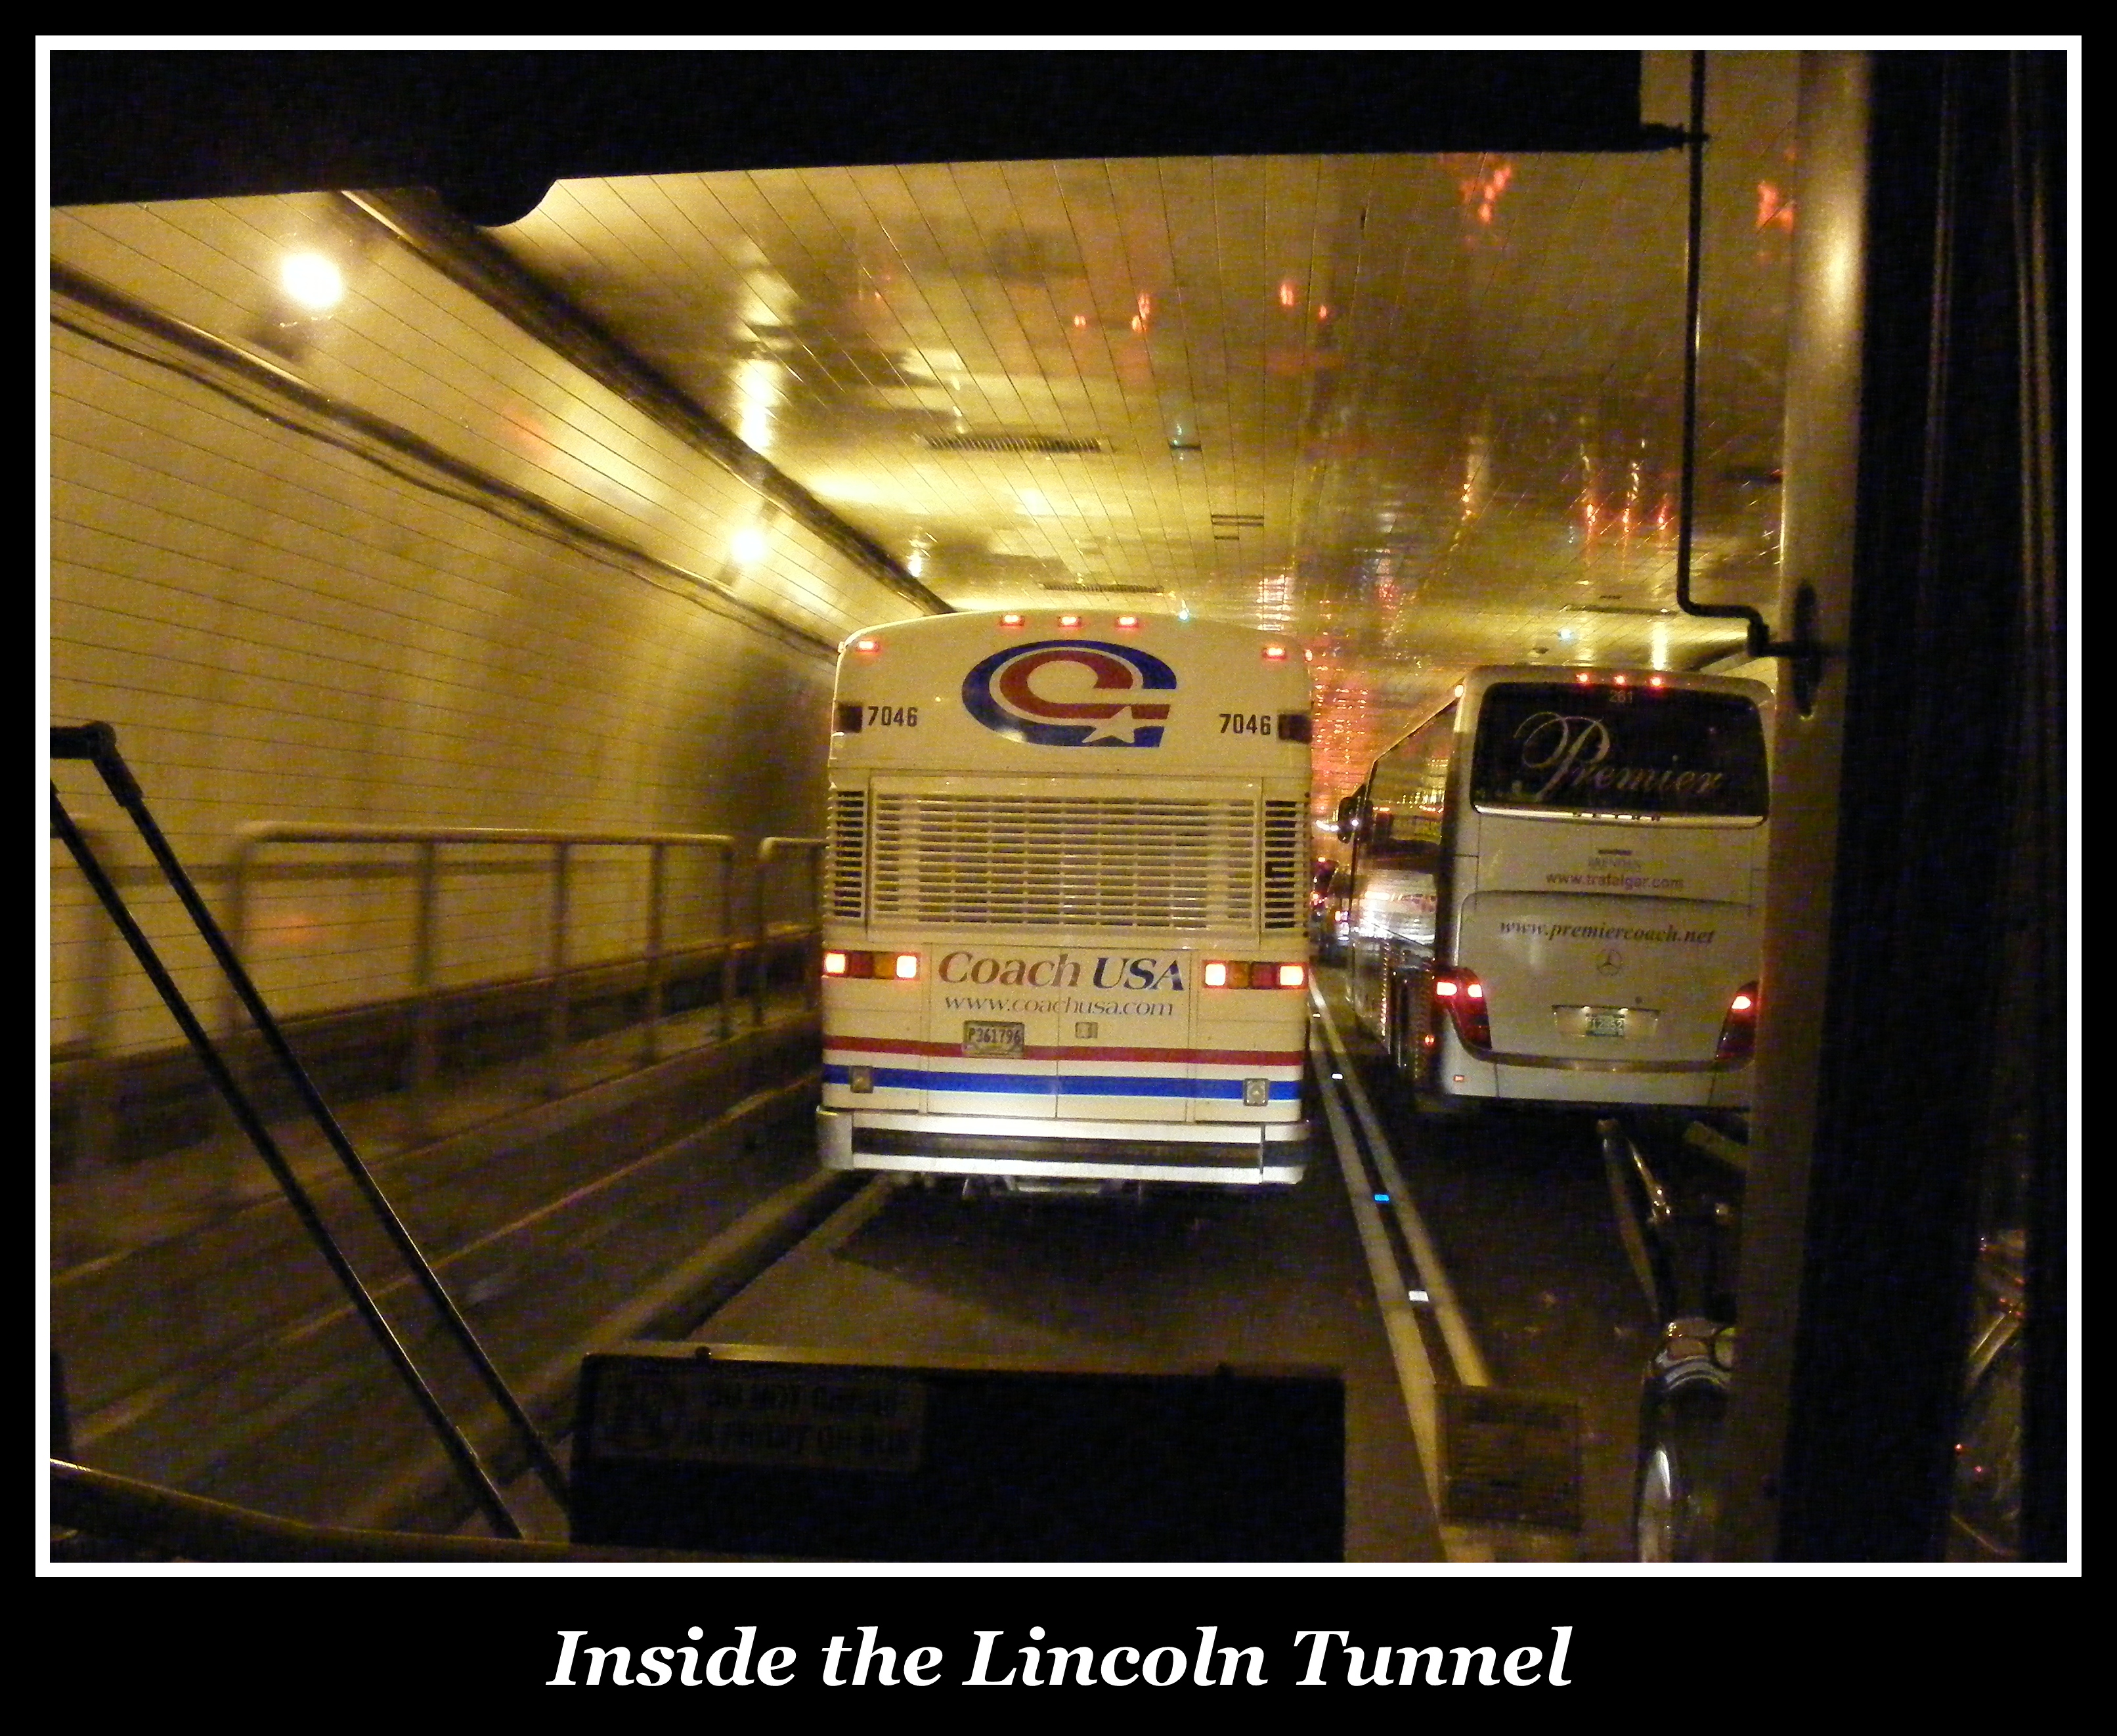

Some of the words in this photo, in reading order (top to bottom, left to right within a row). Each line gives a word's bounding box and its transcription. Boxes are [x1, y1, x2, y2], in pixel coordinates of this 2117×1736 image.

[867, 705, 918, 727] 7046
[1219, 713, 1271, 735] 7046
[1513, 711, 1724, 801] Premier
[1546, 873, 1684, 890] www.trafalgar.com
[1500, 922, 1715, 944] www.premiercoach.net
[938, 952, 1081, 987] Coach
[1092, 957, 1184, 991] USA
[944, 995, 1173, 1017] www.coachusa.com
